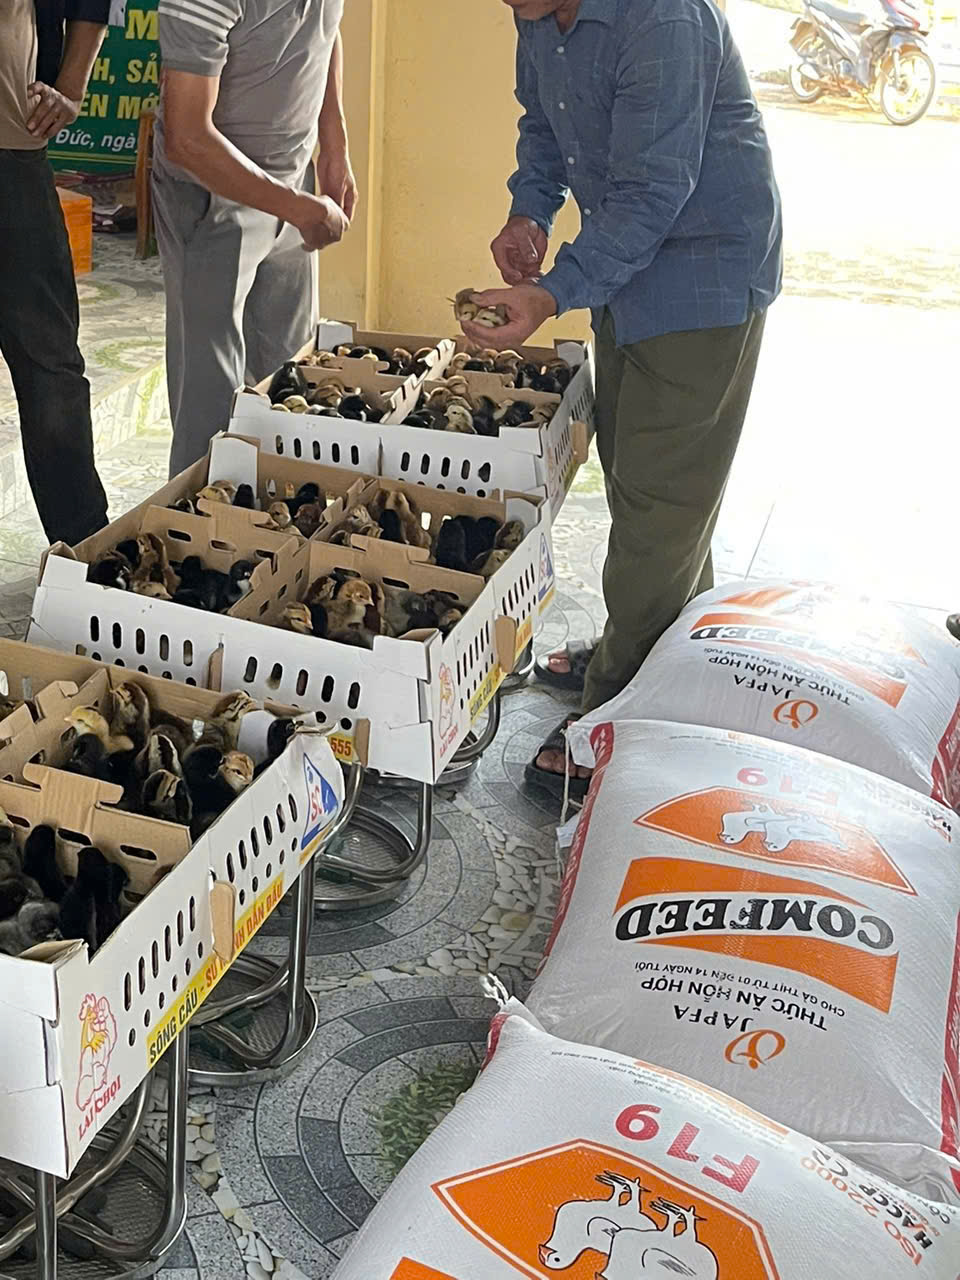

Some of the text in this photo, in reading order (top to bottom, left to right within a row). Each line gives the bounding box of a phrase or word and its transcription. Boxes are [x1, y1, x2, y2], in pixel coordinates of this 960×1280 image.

[101, 132, 138, 153] ngà
[733, 674, 795, 700] JAPFA
[781, 671, 806, 686] ĂN
[808, 681, 851, 706] THỨC
[330, 737, 352, 758] 555
[614, 898, 895, 950] COMFEED
[662, 963, 693, 975] NGÀY
[695, 967, 708, 977] 14
[738, 975, 751, 985] 01
[752, 979, 770, 990] TỪ
[640, 974, 828, 1032] THỨC ĂN HỖN HỢP
[801, 992, 818, 1005] GÀ
[820, 1000, 846, 1017] CHO
[673, 1005, 754, 1033] JAPFA
[615, 1104, 760, 1193] F19
[859, 1183, 933, 1251] HACCP
[883, 1220, 923, 1267] ISO
